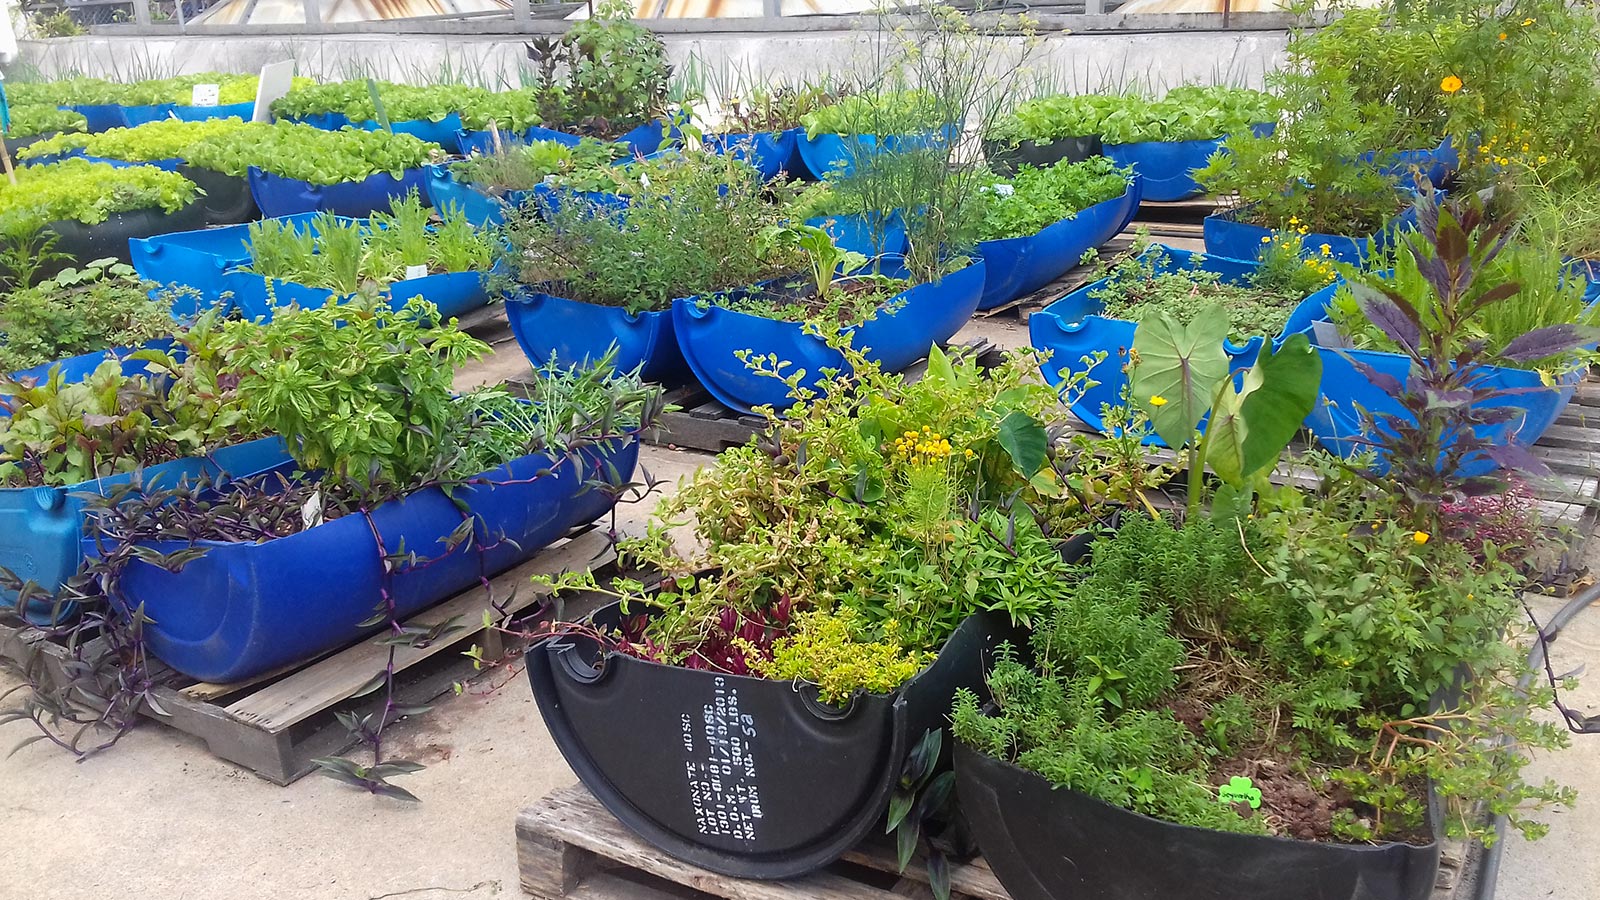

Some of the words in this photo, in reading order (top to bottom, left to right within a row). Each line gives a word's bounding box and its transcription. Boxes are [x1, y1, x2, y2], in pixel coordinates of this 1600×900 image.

[715, 677, 732, 775] 01/19/2013
[728, 689, 739, 726] LBS.
[681, 713, 693, 751] 40SC
[730, 736, 743, 766] 500
[686, 761, 708, 834] NAXONATE
[705, 808, 720, 835] LOT
[741, 812, 756, 840] NET
